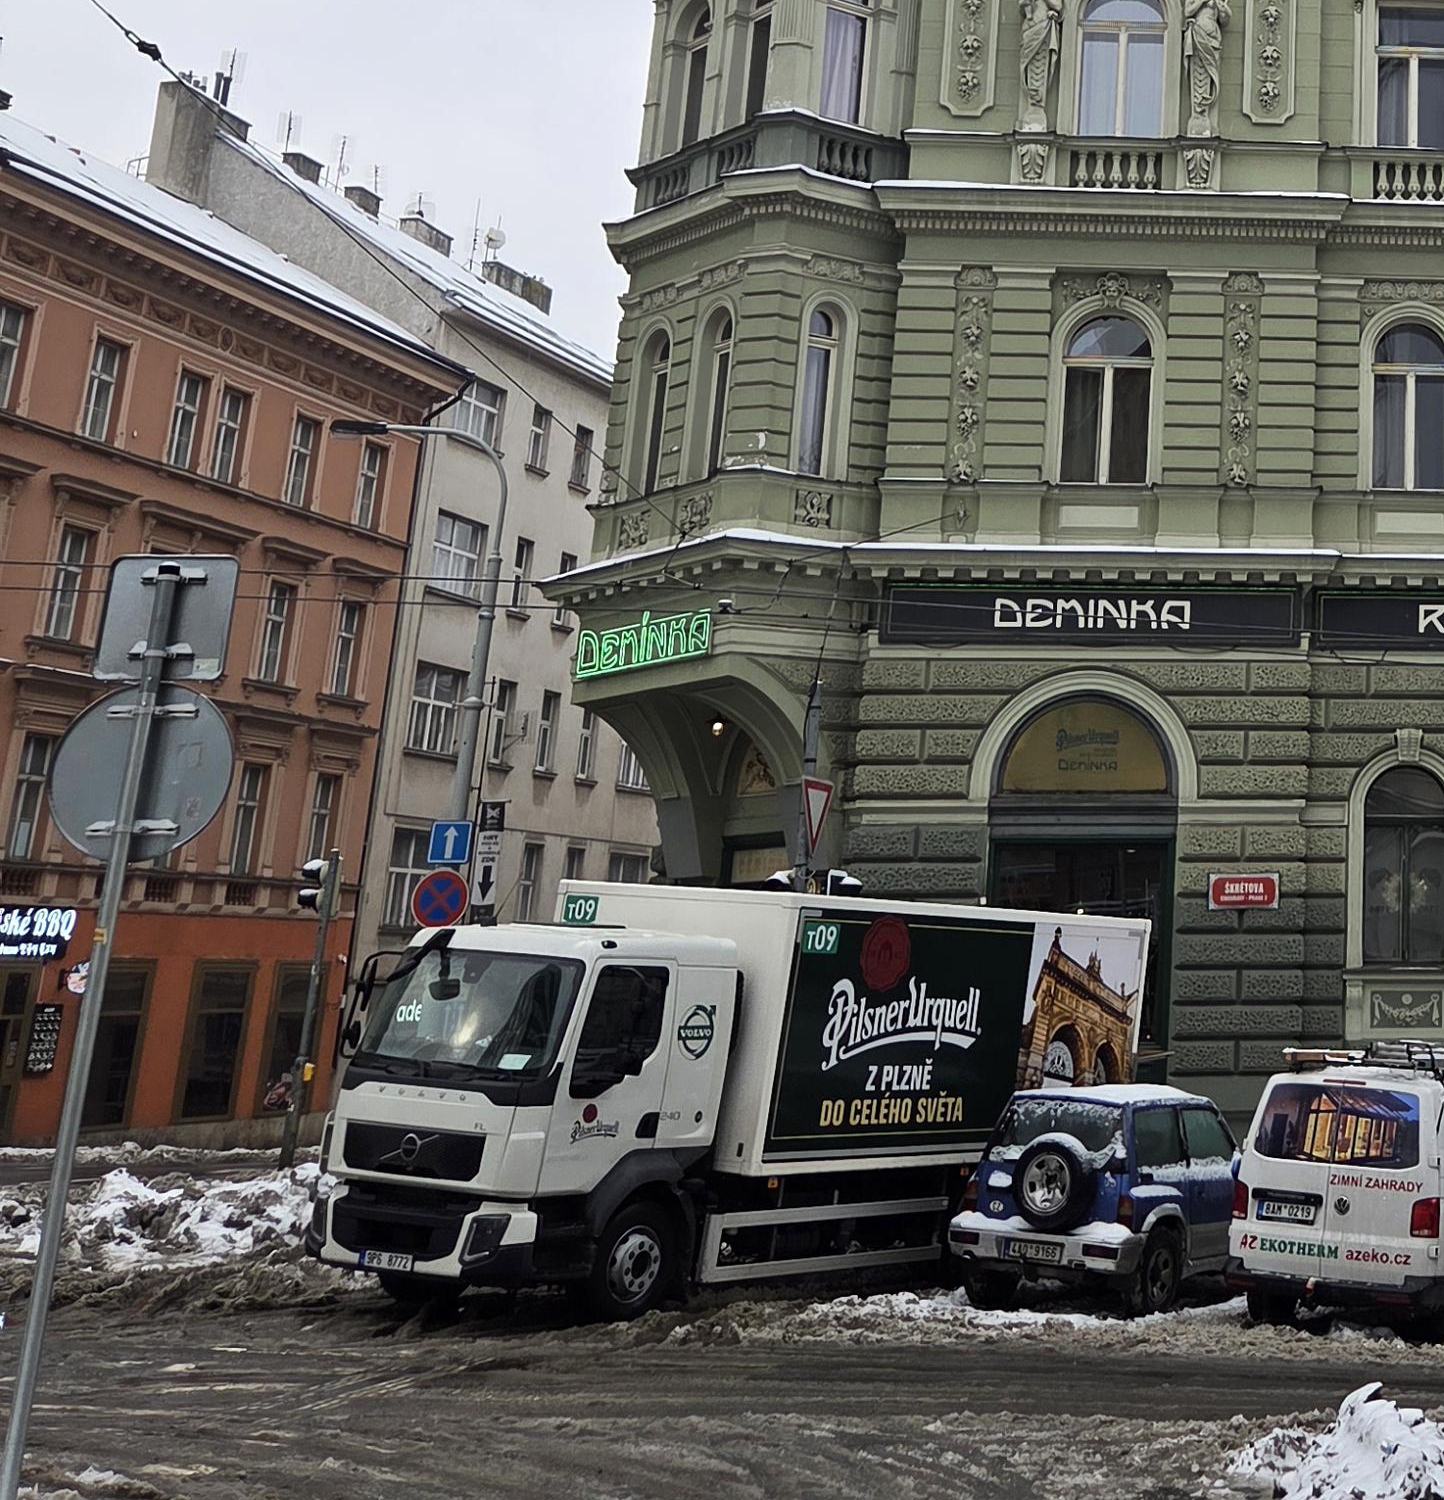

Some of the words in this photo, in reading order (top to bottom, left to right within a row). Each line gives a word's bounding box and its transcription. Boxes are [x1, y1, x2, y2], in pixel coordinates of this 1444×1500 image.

[994, 598, 1191, 629] DEMINKA
[33, 908, 77, 941] BBQ
[568, 900, 596, 922] T09
[806, 924, 838, 951] T09
[679, 1028, 712, 1037] VOLVO
[821, 978, 909, 1071] Pilsner
[865, 1065, 878, 1091] Z
[881, 1058, 933, 1091] PLZNĚ
[819, 1100, 845, 1127] DO
[850, 1091, 912, 1125] CELÉHO
[916, 1090, 963, 1123] SVĚTA
[1330, 1173, 1363, 1187] ZIMNÍ
[1365, 1176, 1423, 1193] ZAHRADY
[1265, 1202, 1282, 1215] 8AM
[1288, 1205, 1311, 1218] 0219
[387, 1254, 409, 1269] 8772
[1034, 1245, 1057, 1258] 9166
[1240, 1233, 1258, 1250] AZ
[1260, 1238, 1339, 1259] EKOTHERM
[1345, 1248, 1411, 1265] azeko.cz
